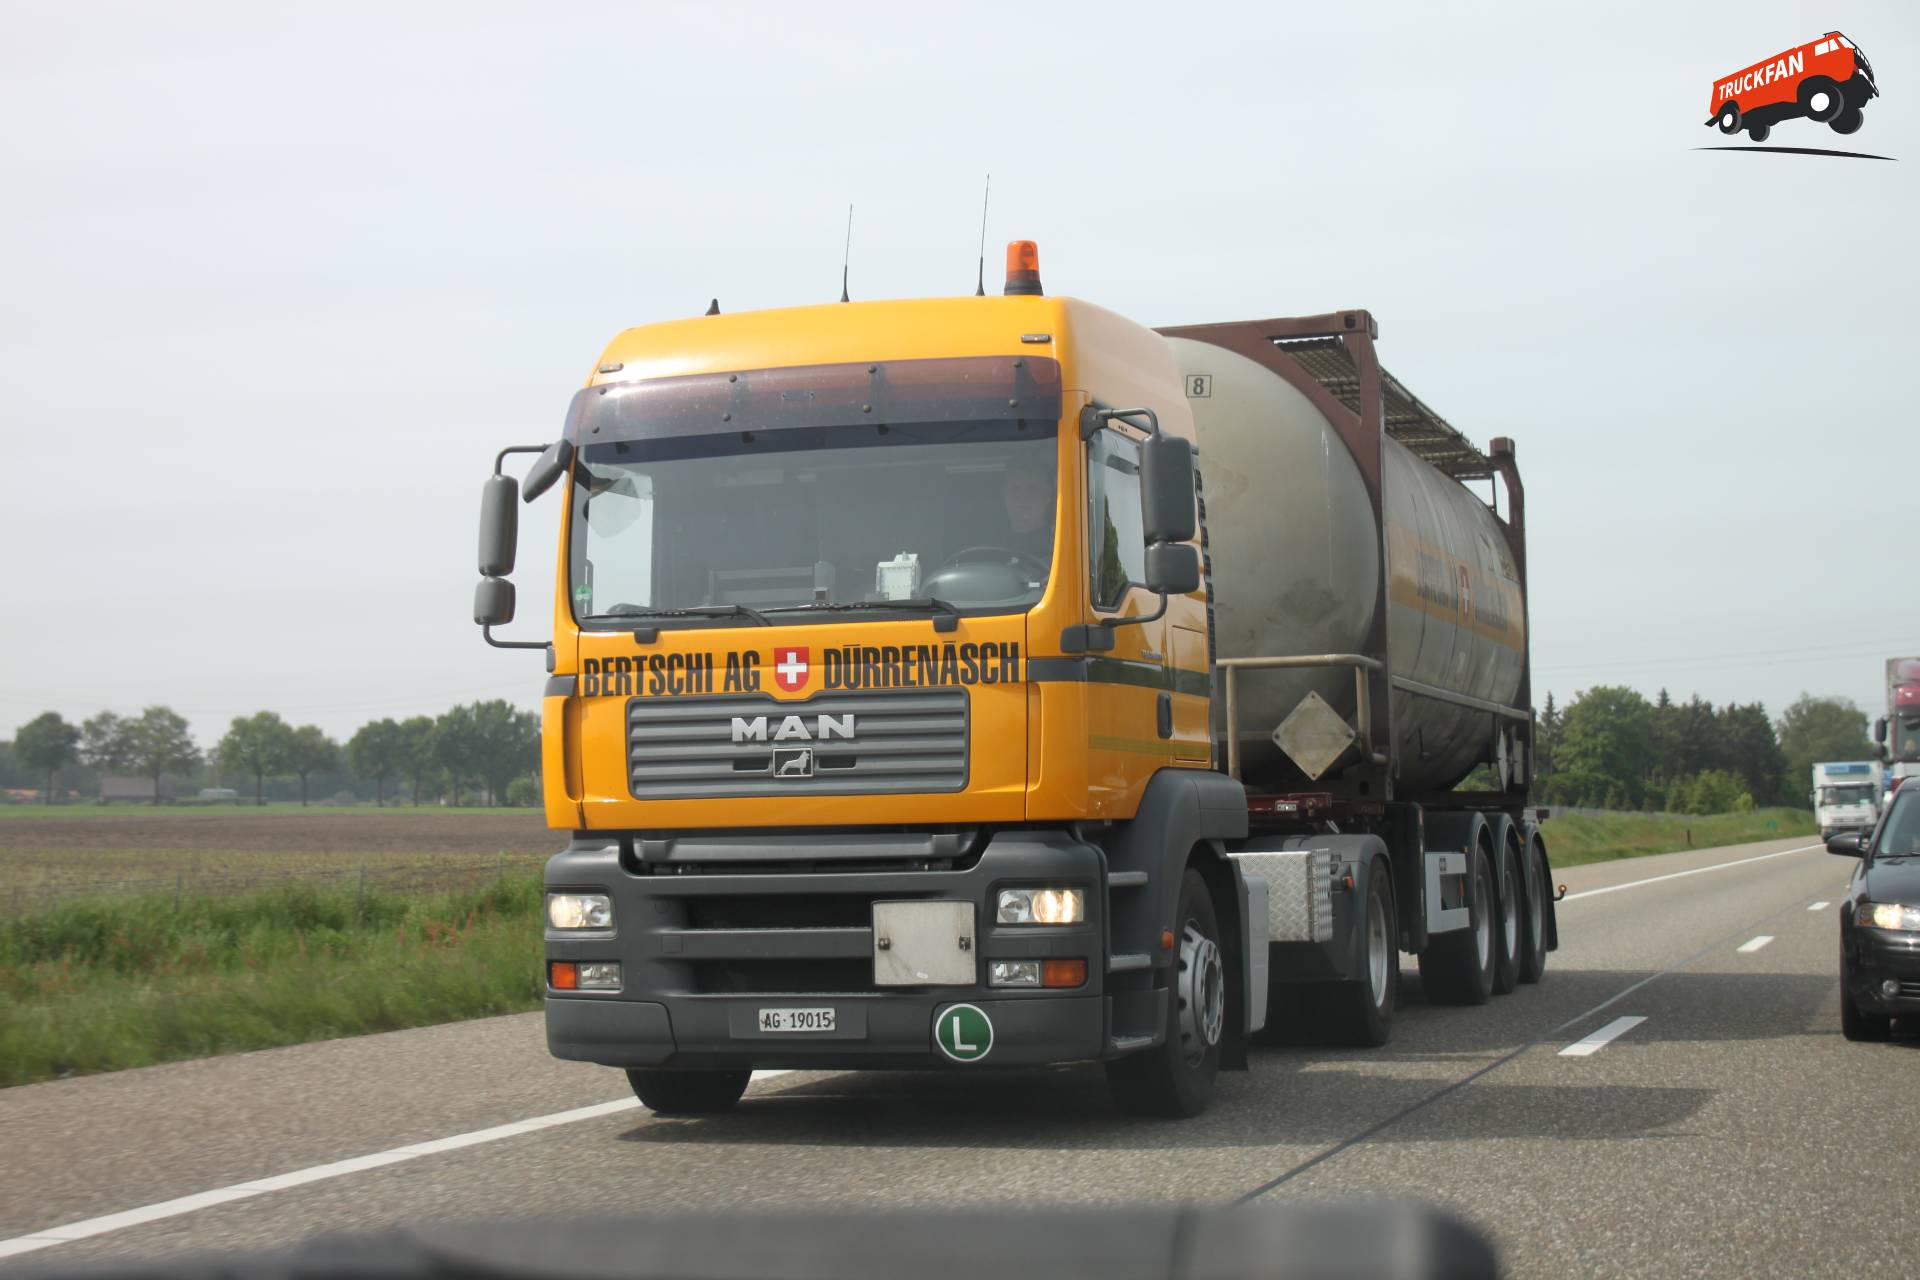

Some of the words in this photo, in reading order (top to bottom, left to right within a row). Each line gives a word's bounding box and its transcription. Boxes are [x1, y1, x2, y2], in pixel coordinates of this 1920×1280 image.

[1193, 377, 1204, 395] 8
[583, 652, 713, 697] BERTSCHI
[723, 650, 761, 692] AG
[731, 714, 855, 742] MAN
[952, 1016, 977, 1051] L
